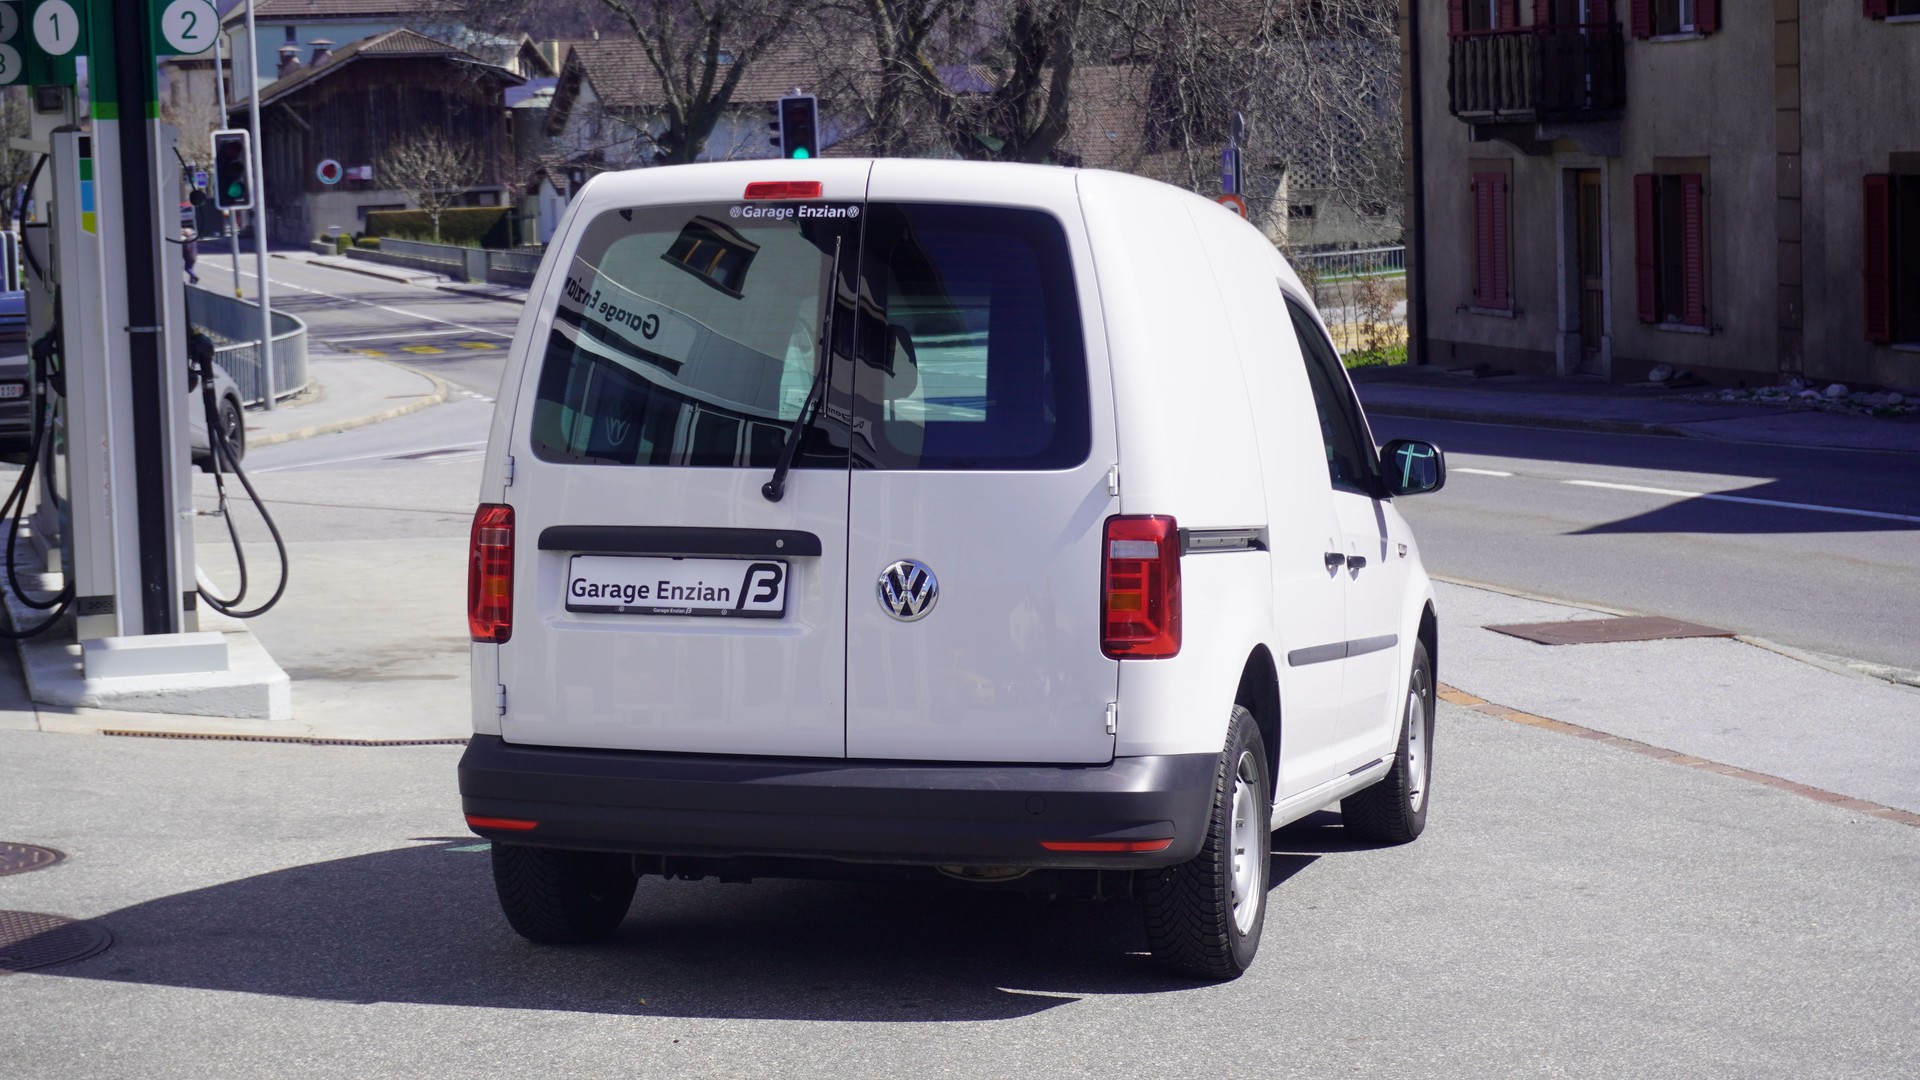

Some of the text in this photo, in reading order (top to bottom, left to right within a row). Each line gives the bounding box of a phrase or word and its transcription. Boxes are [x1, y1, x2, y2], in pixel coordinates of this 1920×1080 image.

[50, 13, 59, 41] 1
[181, 11, 198, 39] 2
[742, 205, 794, 220] Garage
[798, 205, 846, 218] Enzian
[571, 578, 650, 604] Garage
[656, 580, 730, 602] Enzian
